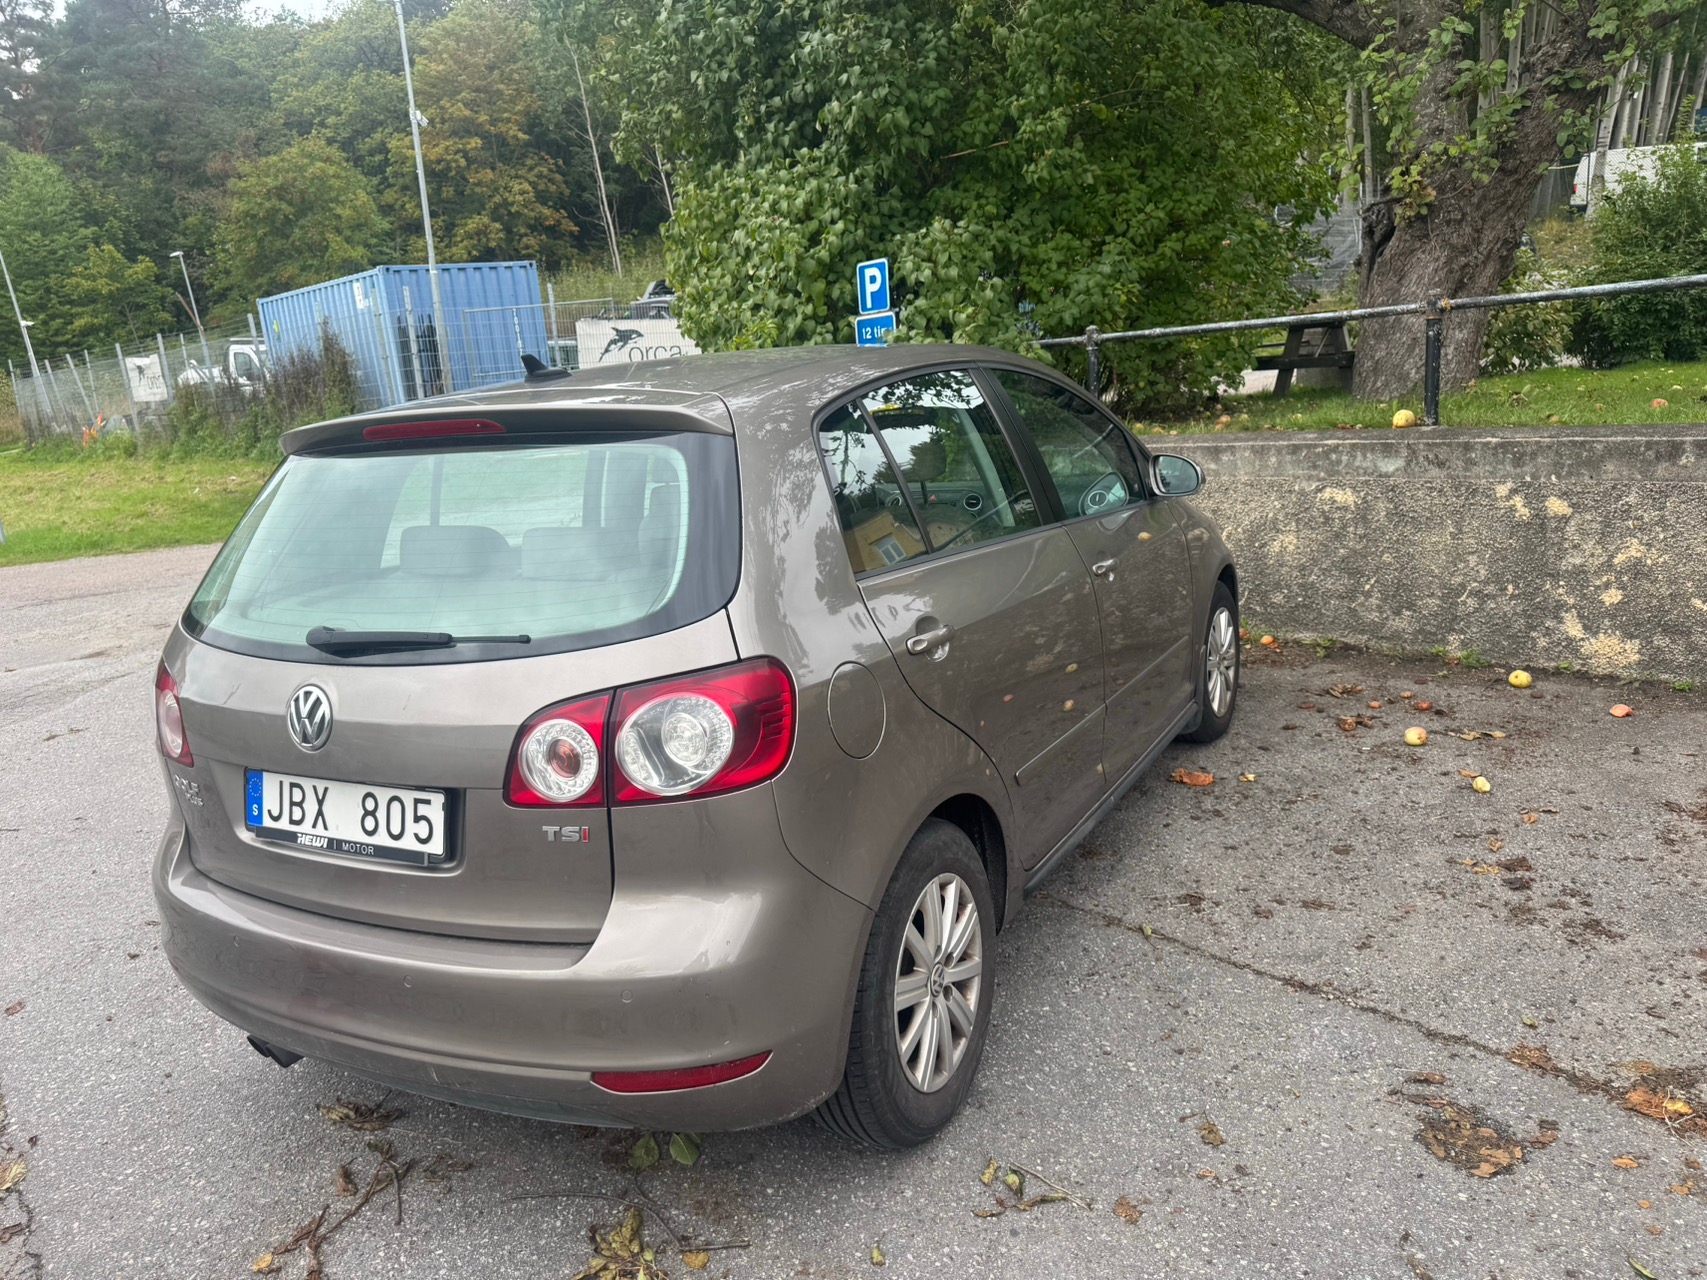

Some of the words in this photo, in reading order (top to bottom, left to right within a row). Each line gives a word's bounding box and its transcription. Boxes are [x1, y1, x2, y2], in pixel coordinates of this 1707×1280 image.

[864, 267, 881, 309] P
[862, 327, 872, 339] 12
[629, 344, 682, 362] orca
[252, 804, 259, 816] S
[267, 780, 329, 831] JBX
[360, 791, 433, 845] 805
[542, 825, 589, 843] TSI
[296, 833, 329, 849] HEWI
[342, 841, 374, 855] MOTOR
